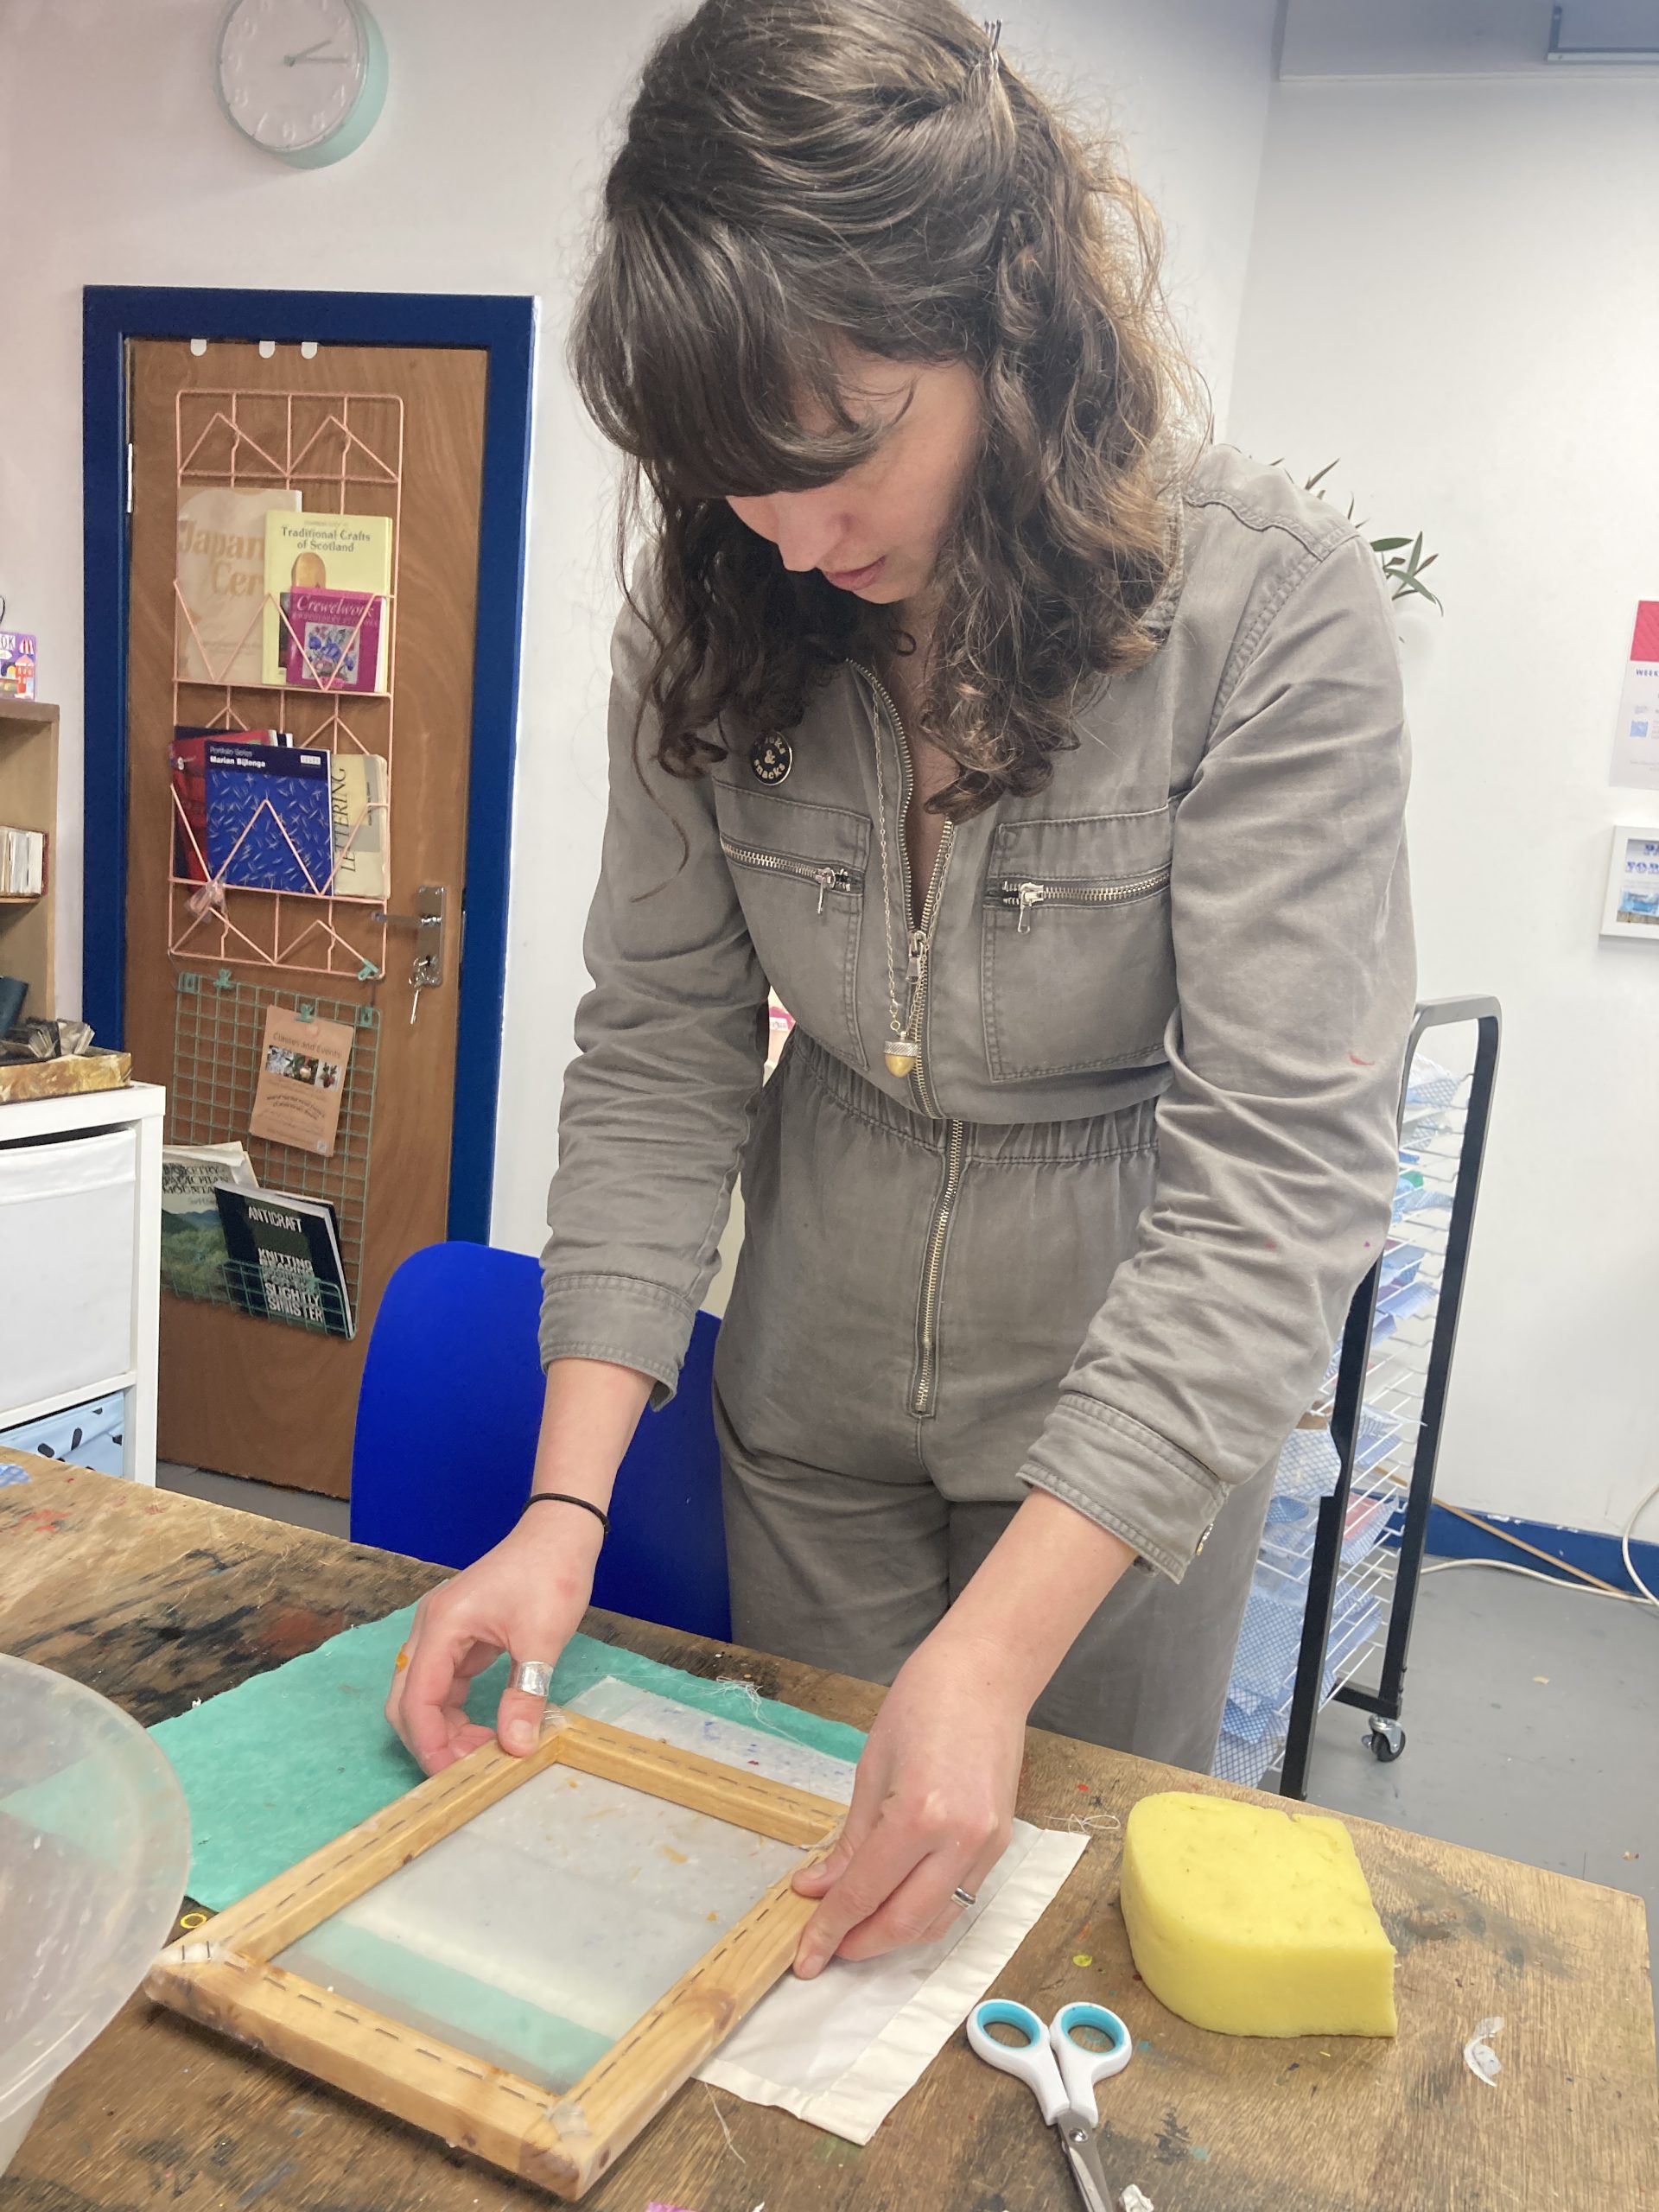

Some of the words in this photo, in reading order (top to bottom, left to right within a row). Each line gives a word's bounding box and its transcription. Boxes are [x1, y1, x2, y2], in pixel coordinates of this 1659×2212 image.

[282, 525, 337, 540] Traditional
[340, 529, 372, 542] Crafts
[297, 539, 308, 550] of
[310, 540, 354, 552] Scotland
[210, 755, 234, 765] Marian
[764, 748, 776, 765] &
[332, 768, 356, 873] LETTERING
[248, 1205, 302, 1233] ANTICRAFT
[258, 1247, 314, 1272] KNITTING
[265, 1283, 320, 1306] SLIGHTLY
[268, 1297, 322, 1322] SINISTER
